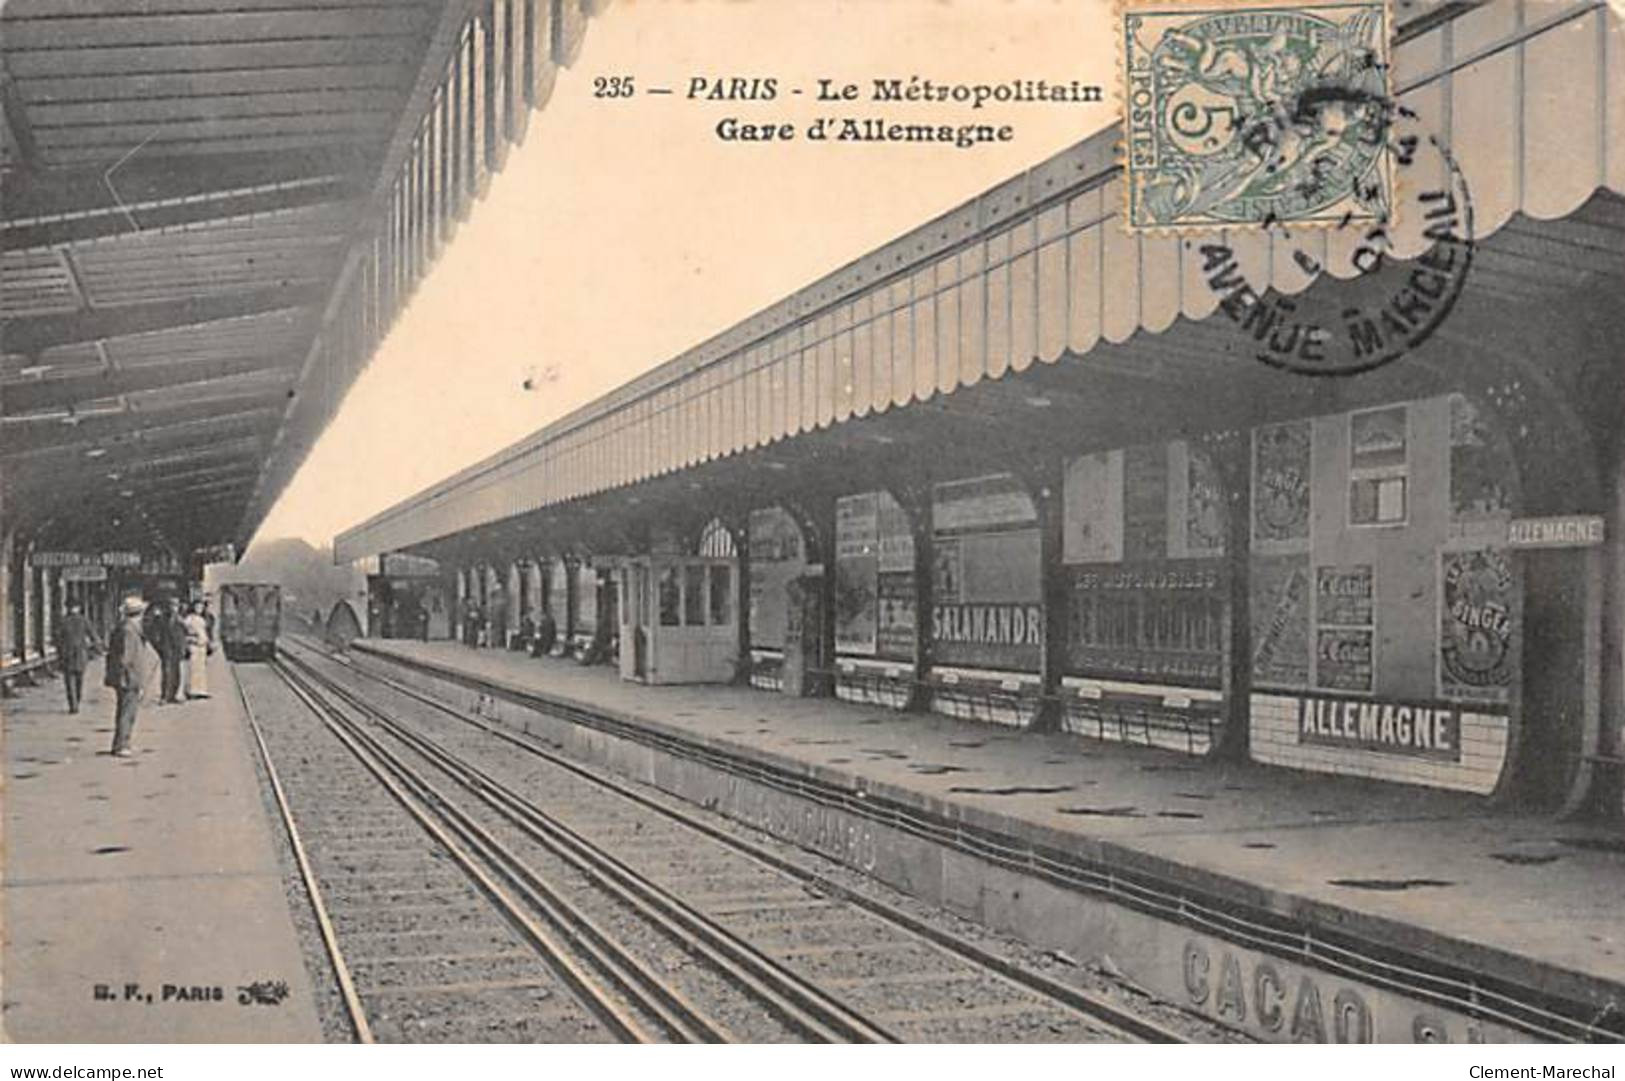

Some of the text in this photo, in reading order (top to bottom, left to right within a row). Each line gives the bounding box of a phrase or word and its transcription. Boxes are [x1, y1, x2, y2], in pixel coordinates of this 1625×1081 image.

[1132, 75, 1154, 166] POSTES
[1508, 519, 1604, 544] ALLEMAGNE
[1303, 699, 1452, 749] ALLEMAGNE
[1182, 938, 1374, 1043] CACAO
